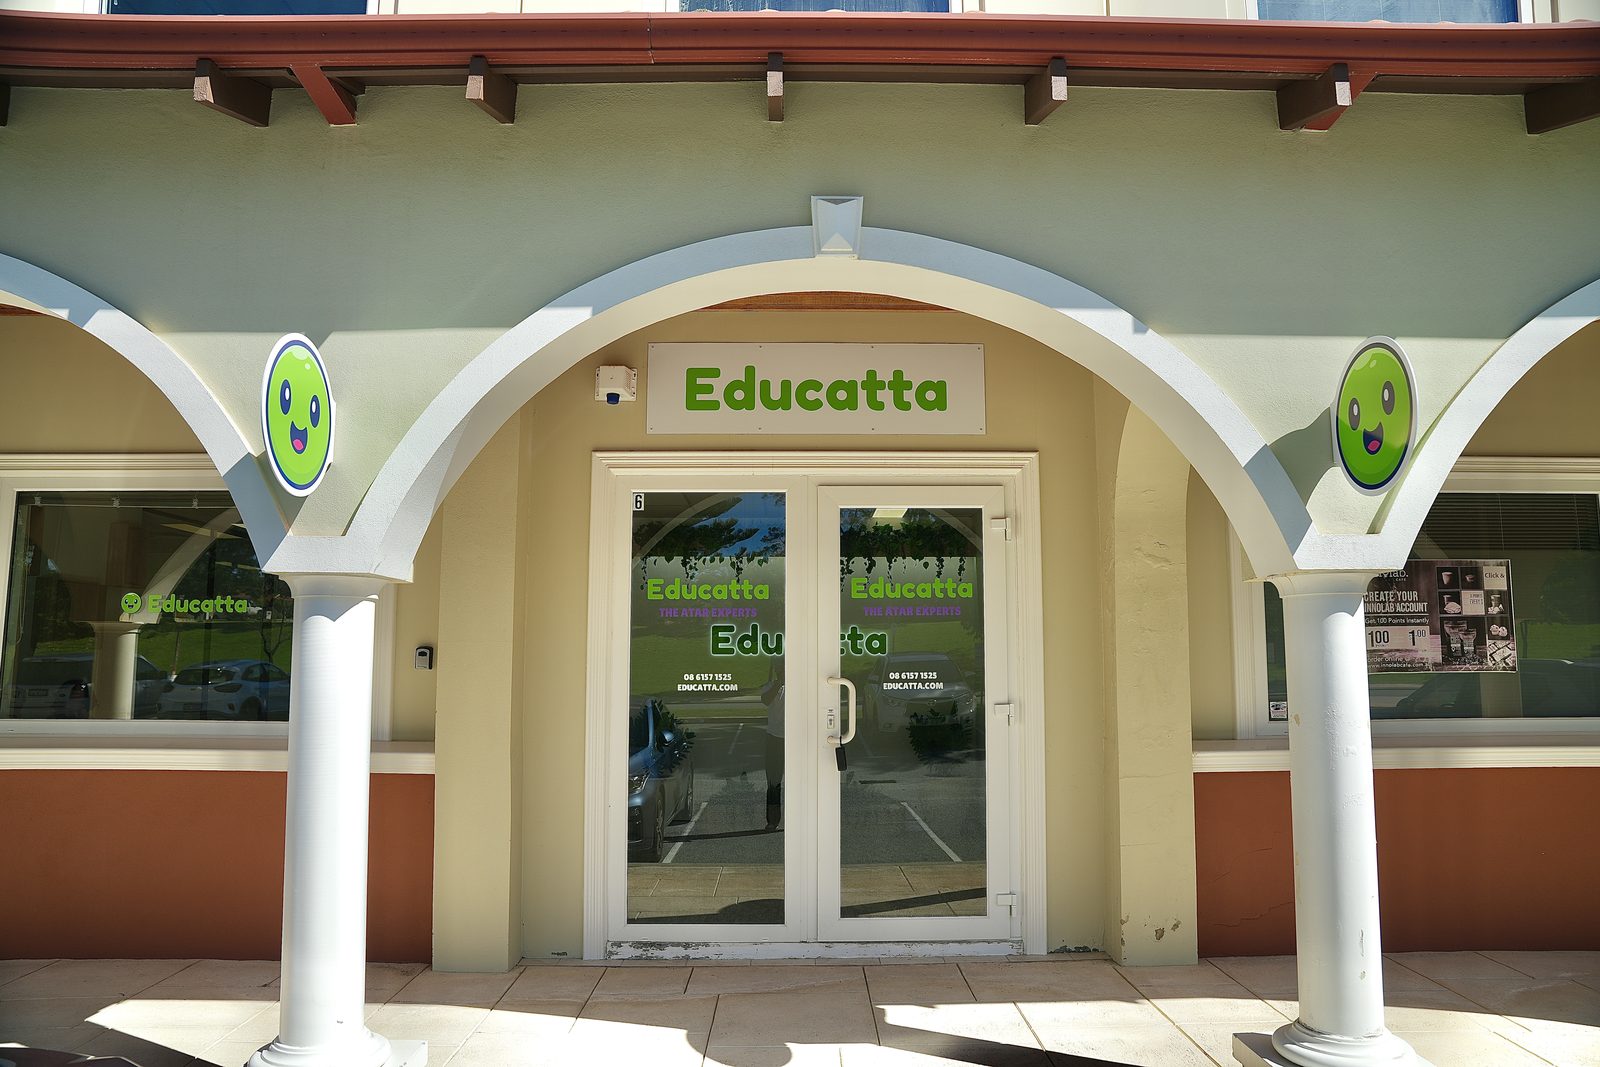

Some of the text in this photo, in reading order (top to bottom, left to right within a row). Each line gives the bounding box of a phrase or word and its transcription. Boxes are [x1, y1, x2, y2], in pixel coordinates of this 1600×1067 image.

[685, 365, 948, 412] Educatta
[635, 494, 643, 509] 6
[647, 578, 770, 600] Educatta
[850, 576, 973, 599] Educatta
[1363, 590, 1419, 602] CREATE YOUR
[147, 593, 248, 613] Educatta
[1364, 602, 1429, 613] INNOLAB ACCOUNT
[660, 607, 758, 618] THE ATAR EXPERTS
[864, 606, 961, 616] THE ATAR EXPERTS
[1368, 630, 1390, 647] 100
[683, 673, 732, 681] 08 6157 1525
[889, 672, 938, 680] 08 6157 1525
[677, 683, 738, 692] EDUCATTA.COM
[883, 682, 944, 690] EDUCATTA.COM
